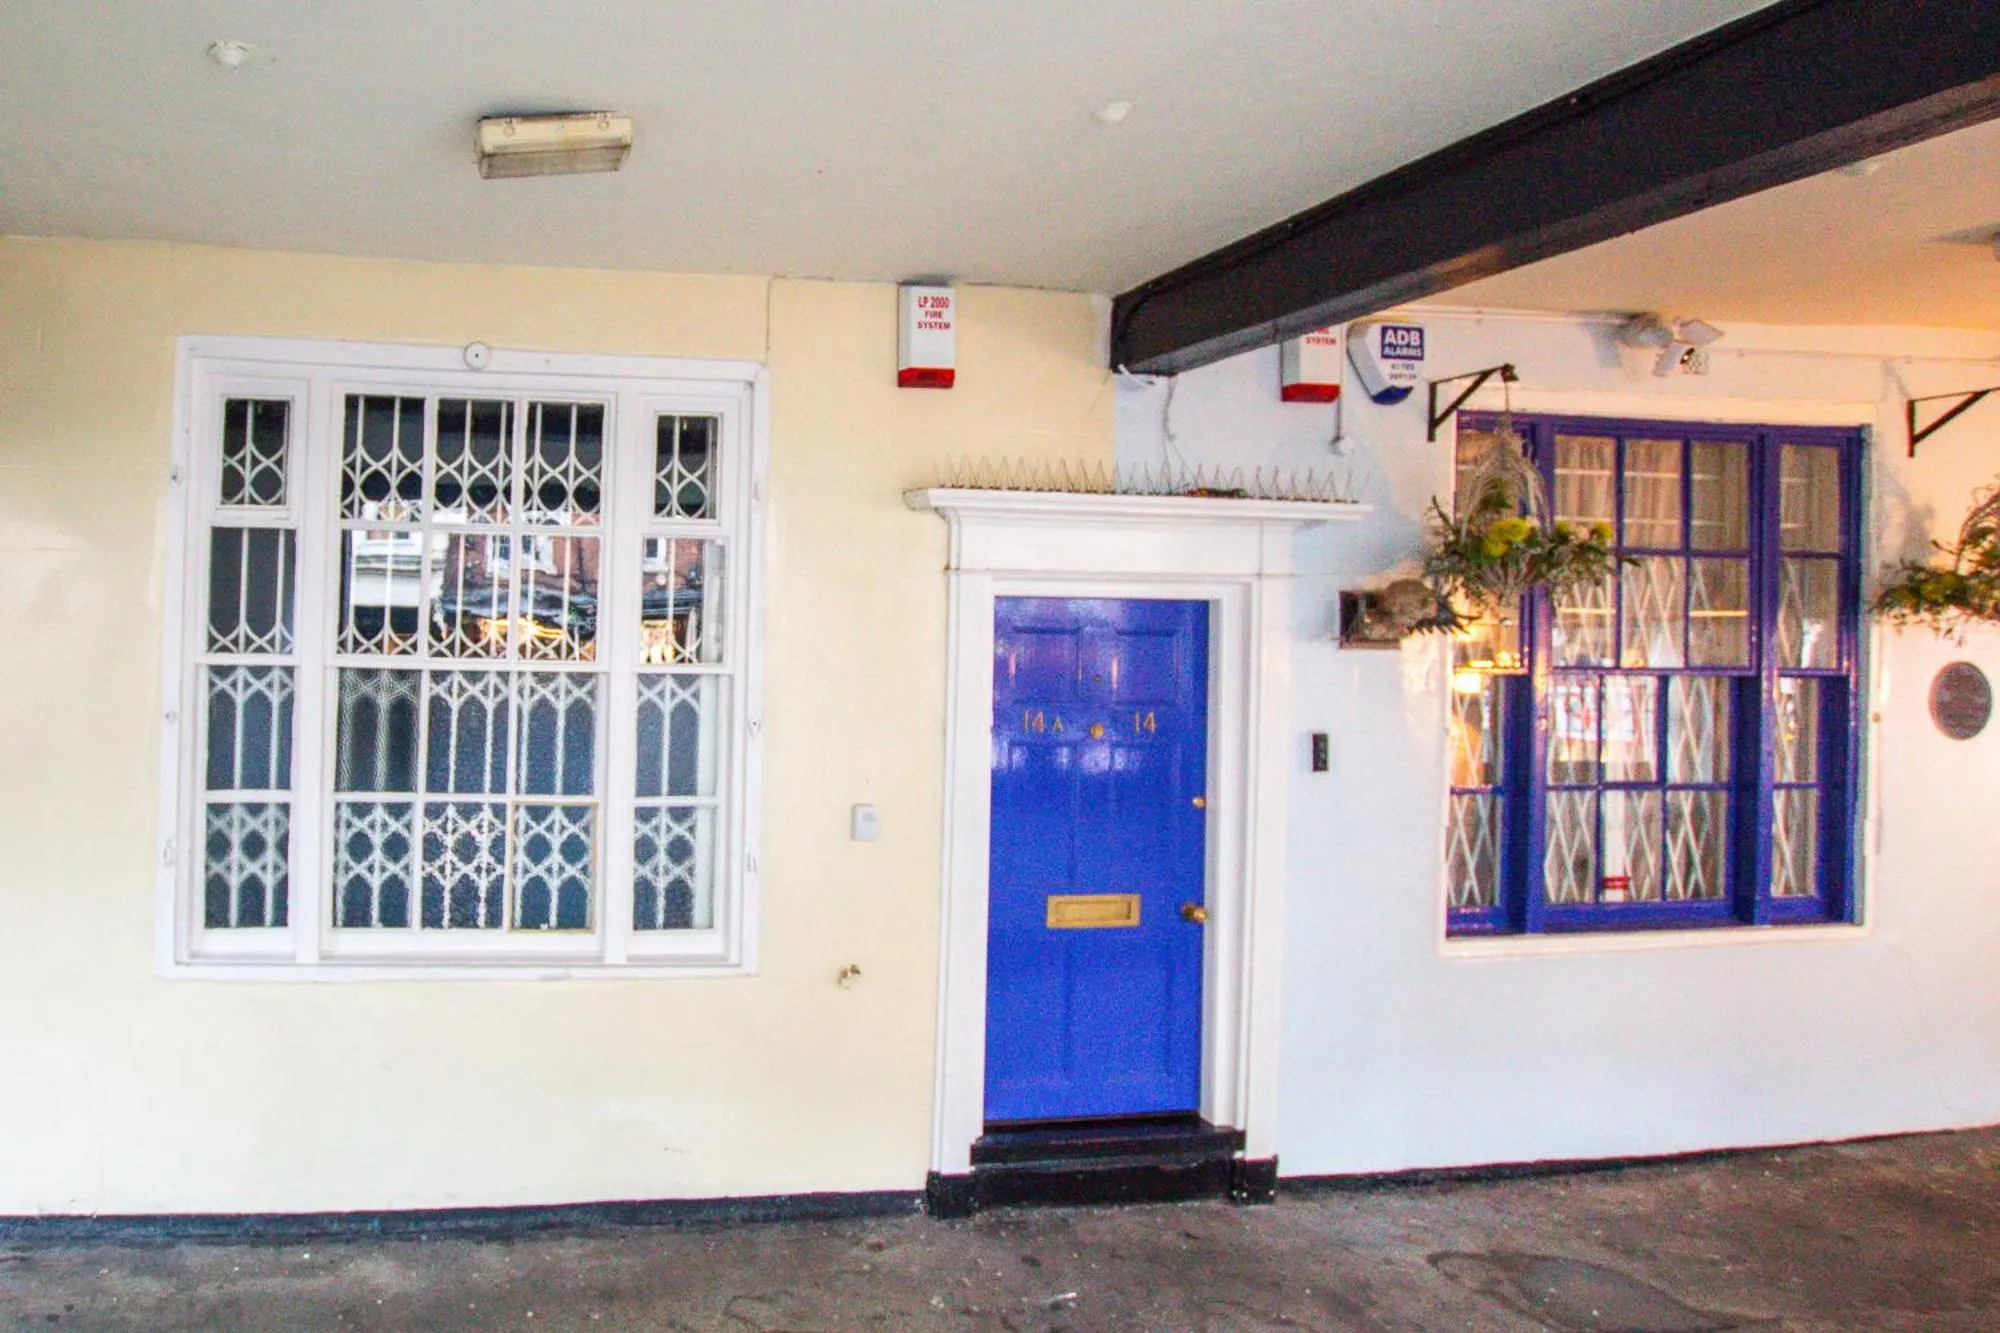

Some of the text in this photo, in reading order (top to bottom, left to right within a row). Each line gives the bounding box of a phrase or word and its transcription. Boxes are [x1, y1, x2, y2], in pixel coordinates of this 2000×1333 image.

[918, 296, 950, 308] LP 2000
[924, 310, 943, 319] FIRE
[917, 321, 951, 329] SYSTEM
[1306, 336, 1337, 345] SYSTEM
[1384, 328, 1421, 346] ADB
[1383, 346, 1422, 357] ALARMS
[1135, 711, 1157, 736] 14
